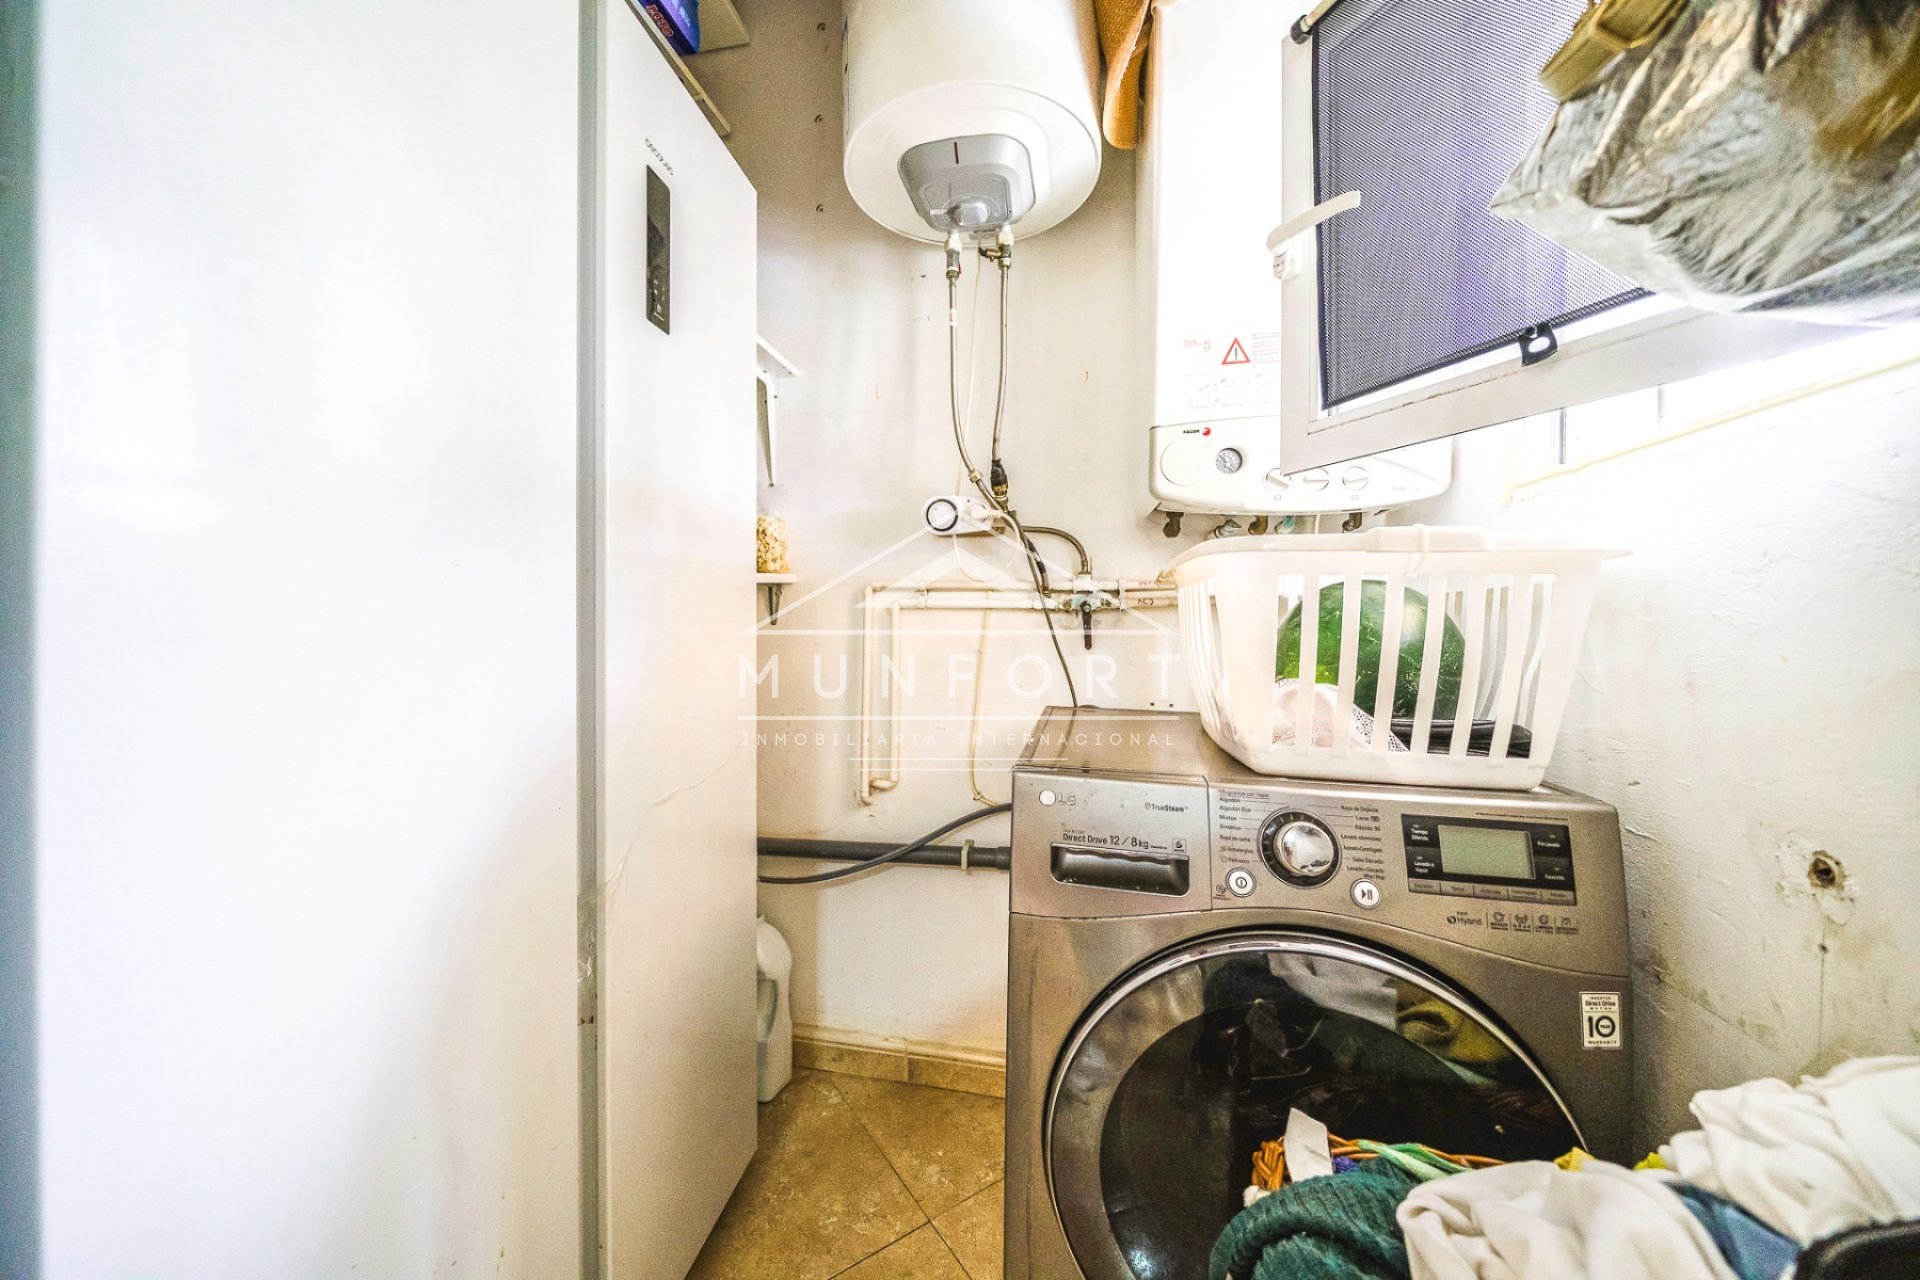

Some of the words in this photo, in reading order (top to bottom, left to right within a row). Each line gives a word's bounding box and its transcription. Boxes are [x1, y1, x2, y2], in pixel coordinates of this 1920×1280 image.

[1058, 793, 1077, 806] LG
[1063, 833, 1086, 843] Direct
[1087, 834, 1108, 845] Drive
[1110, 835, 1120, 846] 12
[1587, 1015, 1616, 1038] 10
